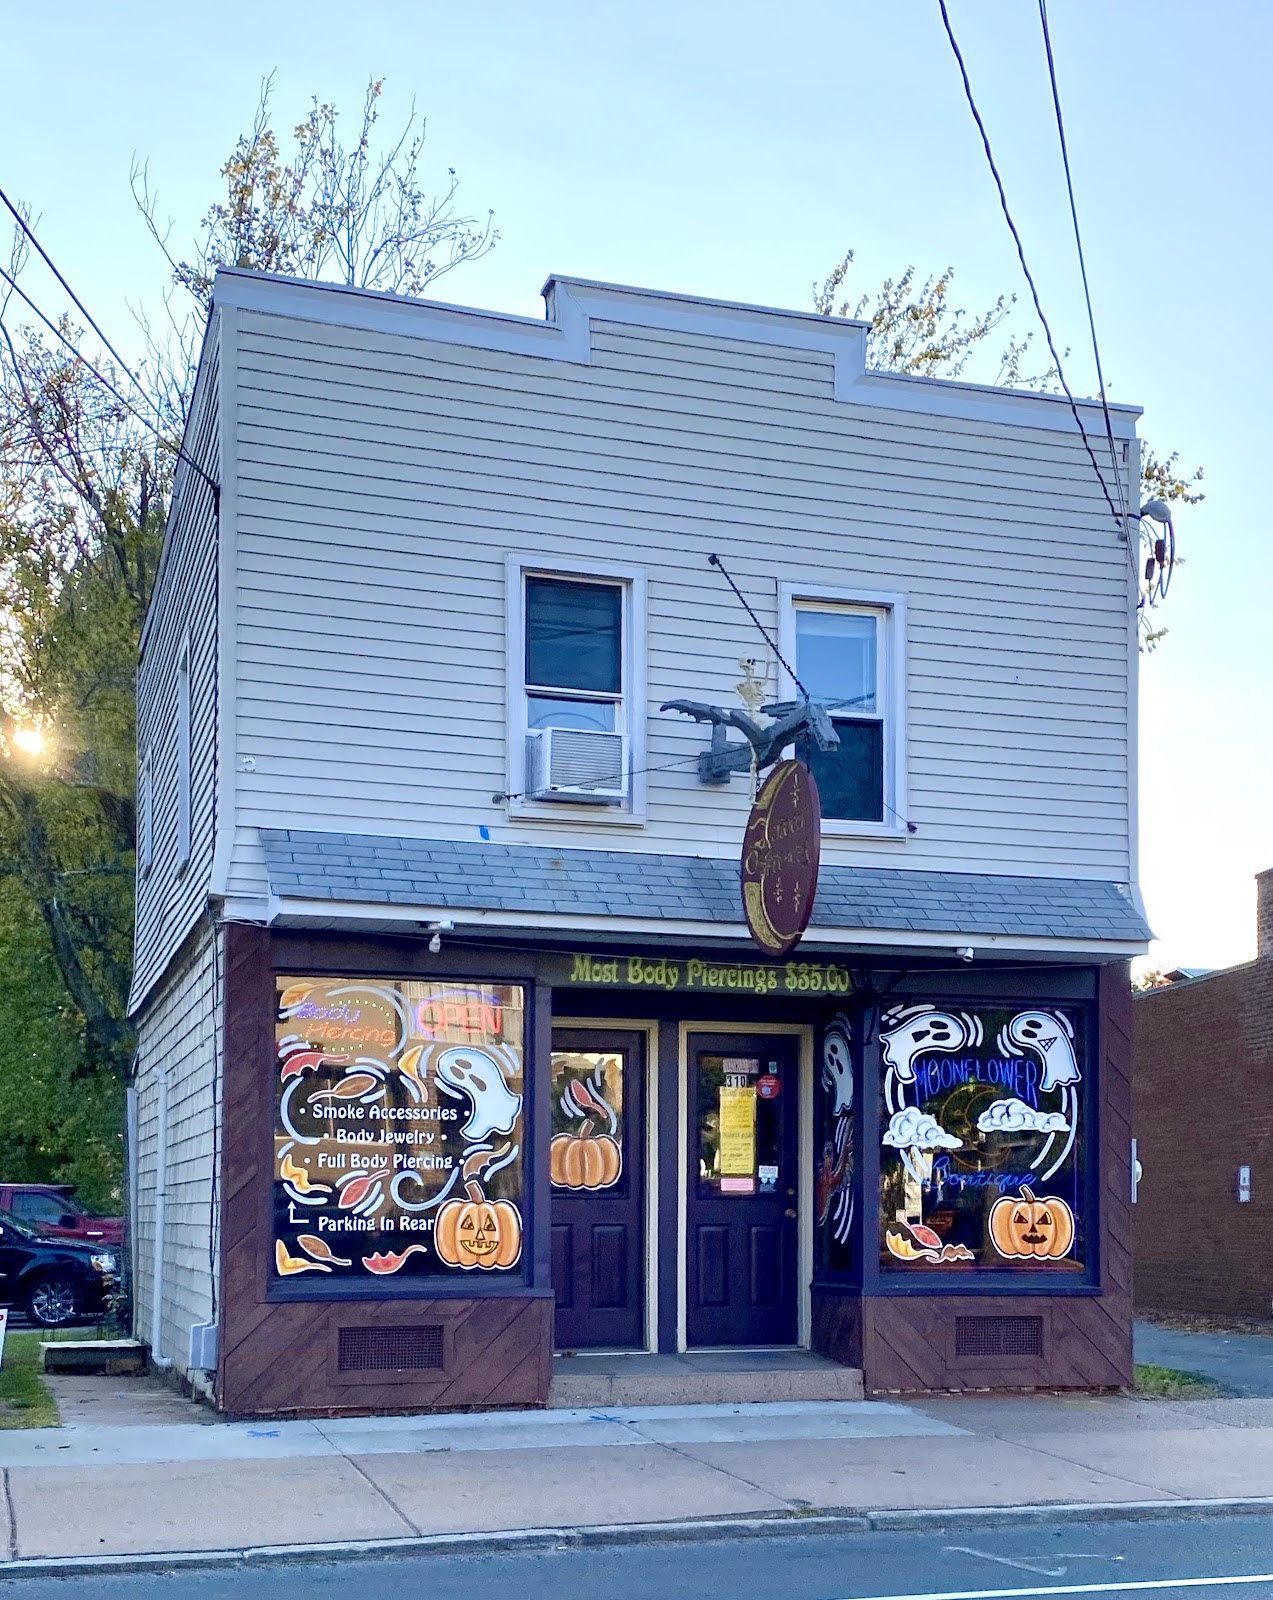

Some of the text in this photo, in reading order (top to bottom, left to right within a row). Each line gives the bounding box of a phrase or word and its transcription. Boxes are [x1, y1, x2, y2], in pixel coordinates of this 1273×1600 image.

[570, 954, 849, 994] Most Body Piercings $35.00
[418, 1001, 503, 1034] OPEN
[304, 1021, 396, 1048] Piercing
[726, 1075, 746, 1088] 310
[914, 1058, 1038, 1110] MOONFLOWER
[312, 1104, 458, 1121] Smoke Accessories
[336, 1129, 434, 1144] Body Jewelry
[317, 1153, 453, 1170] Full Body Piercing
[318, 1216, 435, 1232] Parking In Rear
